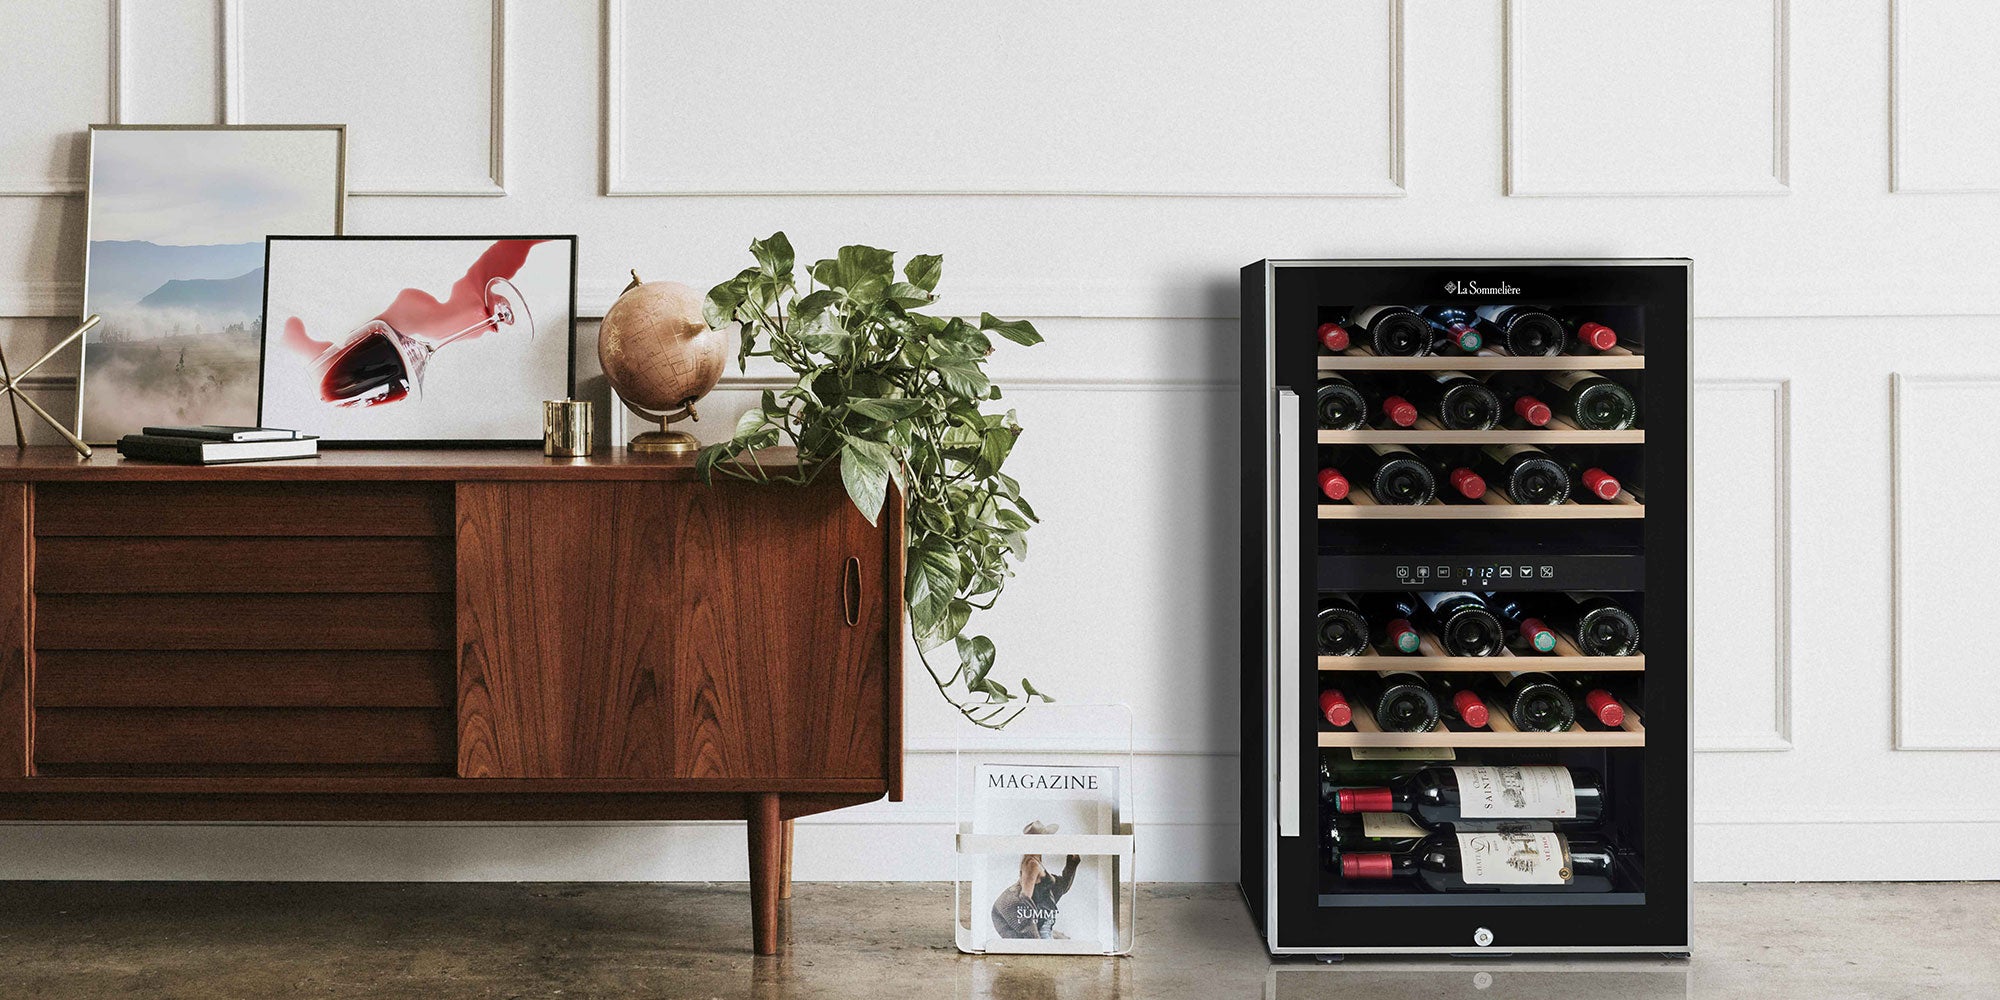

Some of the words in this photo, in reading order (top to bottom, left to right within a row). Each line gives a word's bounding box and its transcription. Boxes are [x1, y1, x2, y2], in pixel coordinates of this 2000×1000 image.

[1457, 280, 1468, 295] La
[1469, 280, 1521, 295] Sommelière
[988, 773, 1098, 790] MAGAZINE
